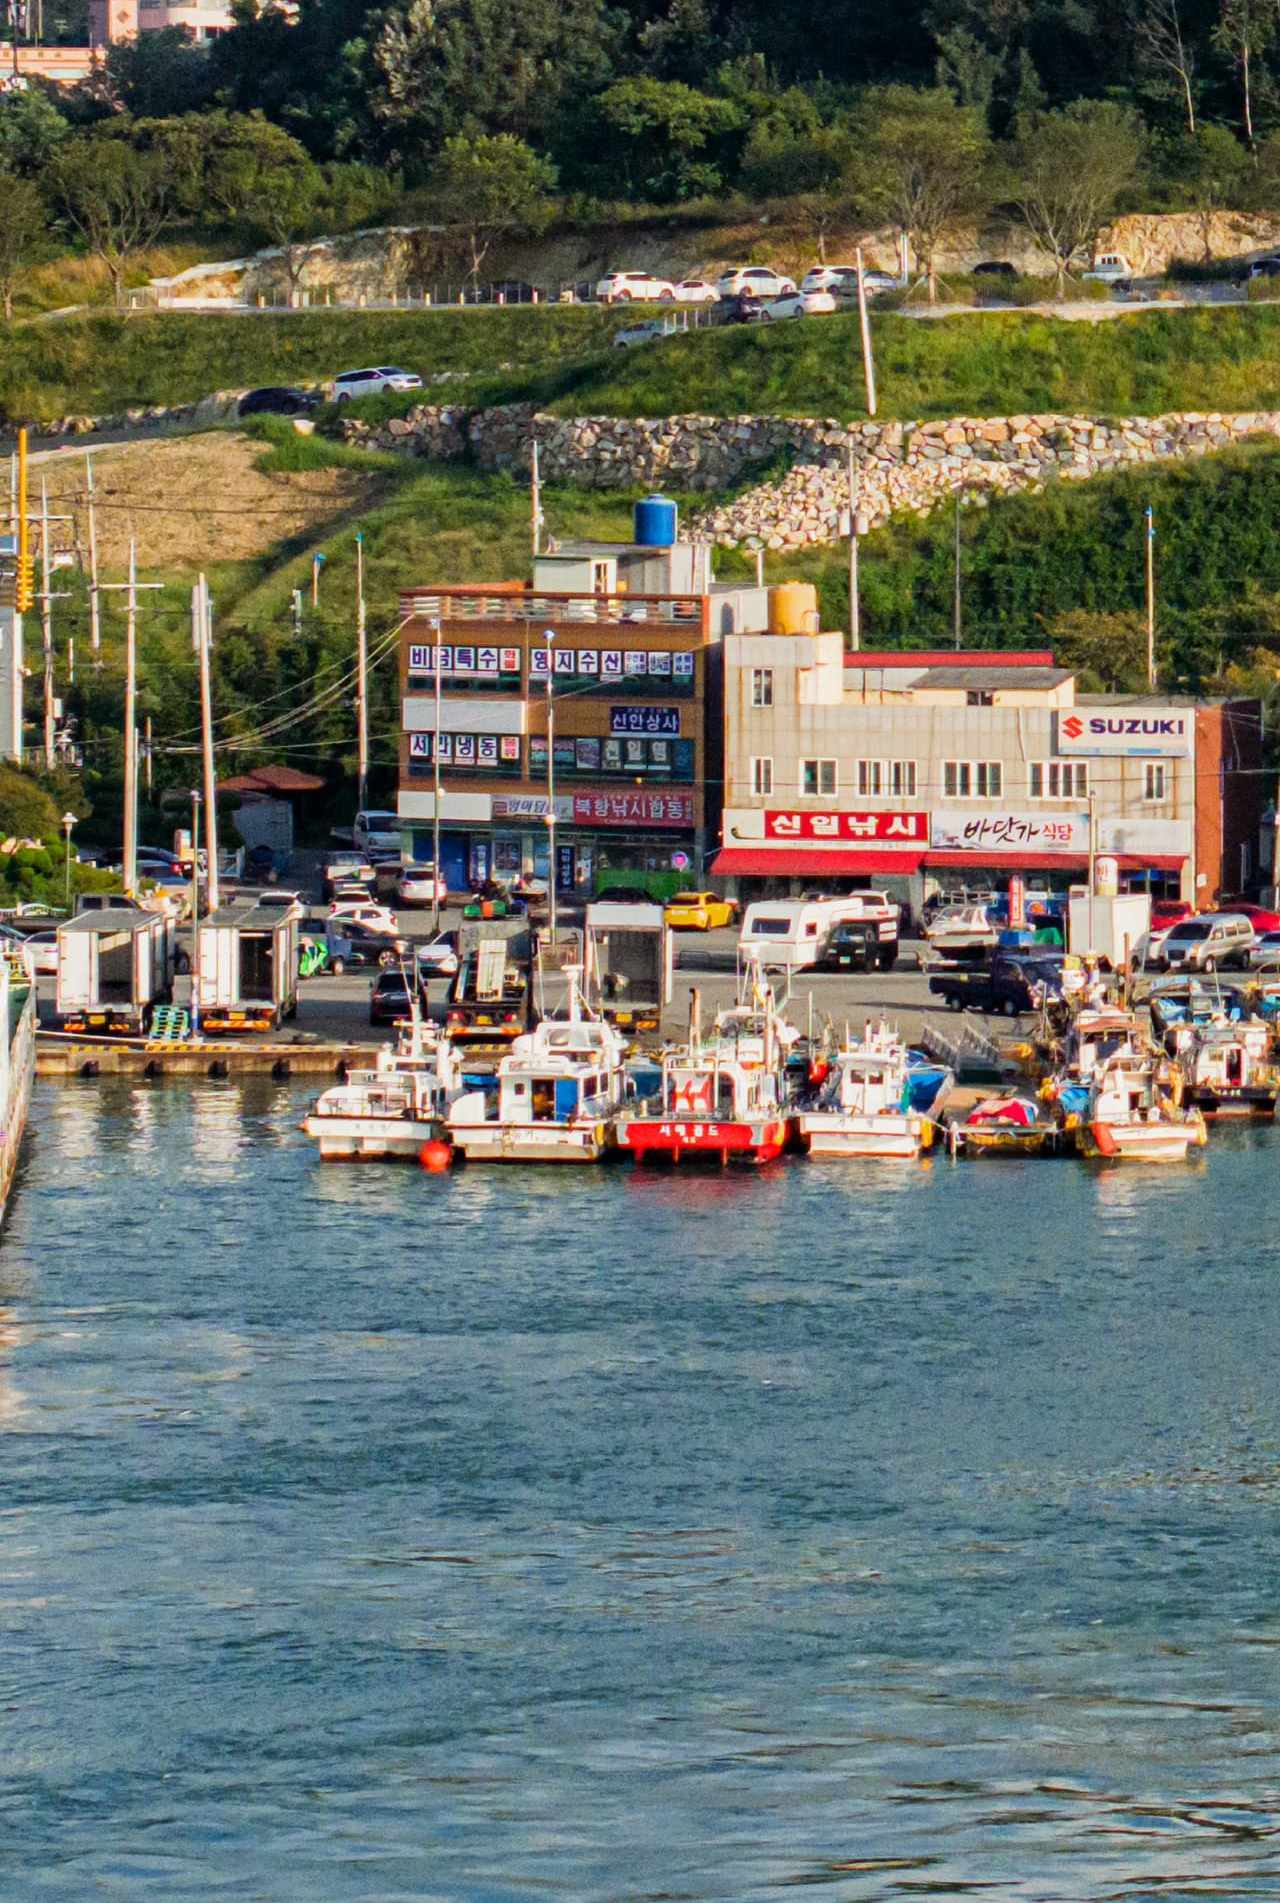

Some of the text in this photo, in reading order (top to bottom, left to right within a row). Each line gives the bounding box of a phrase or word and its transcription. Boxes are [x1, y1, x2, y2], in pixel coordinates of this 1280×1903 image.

[612, 713, 679, 732] 신안상사
[1089, 718, 1184, 735] SUZUKI
[771, 814, 917, 836] 신일낚시
[963, 816, 1074, 843] 바닷가 식당
